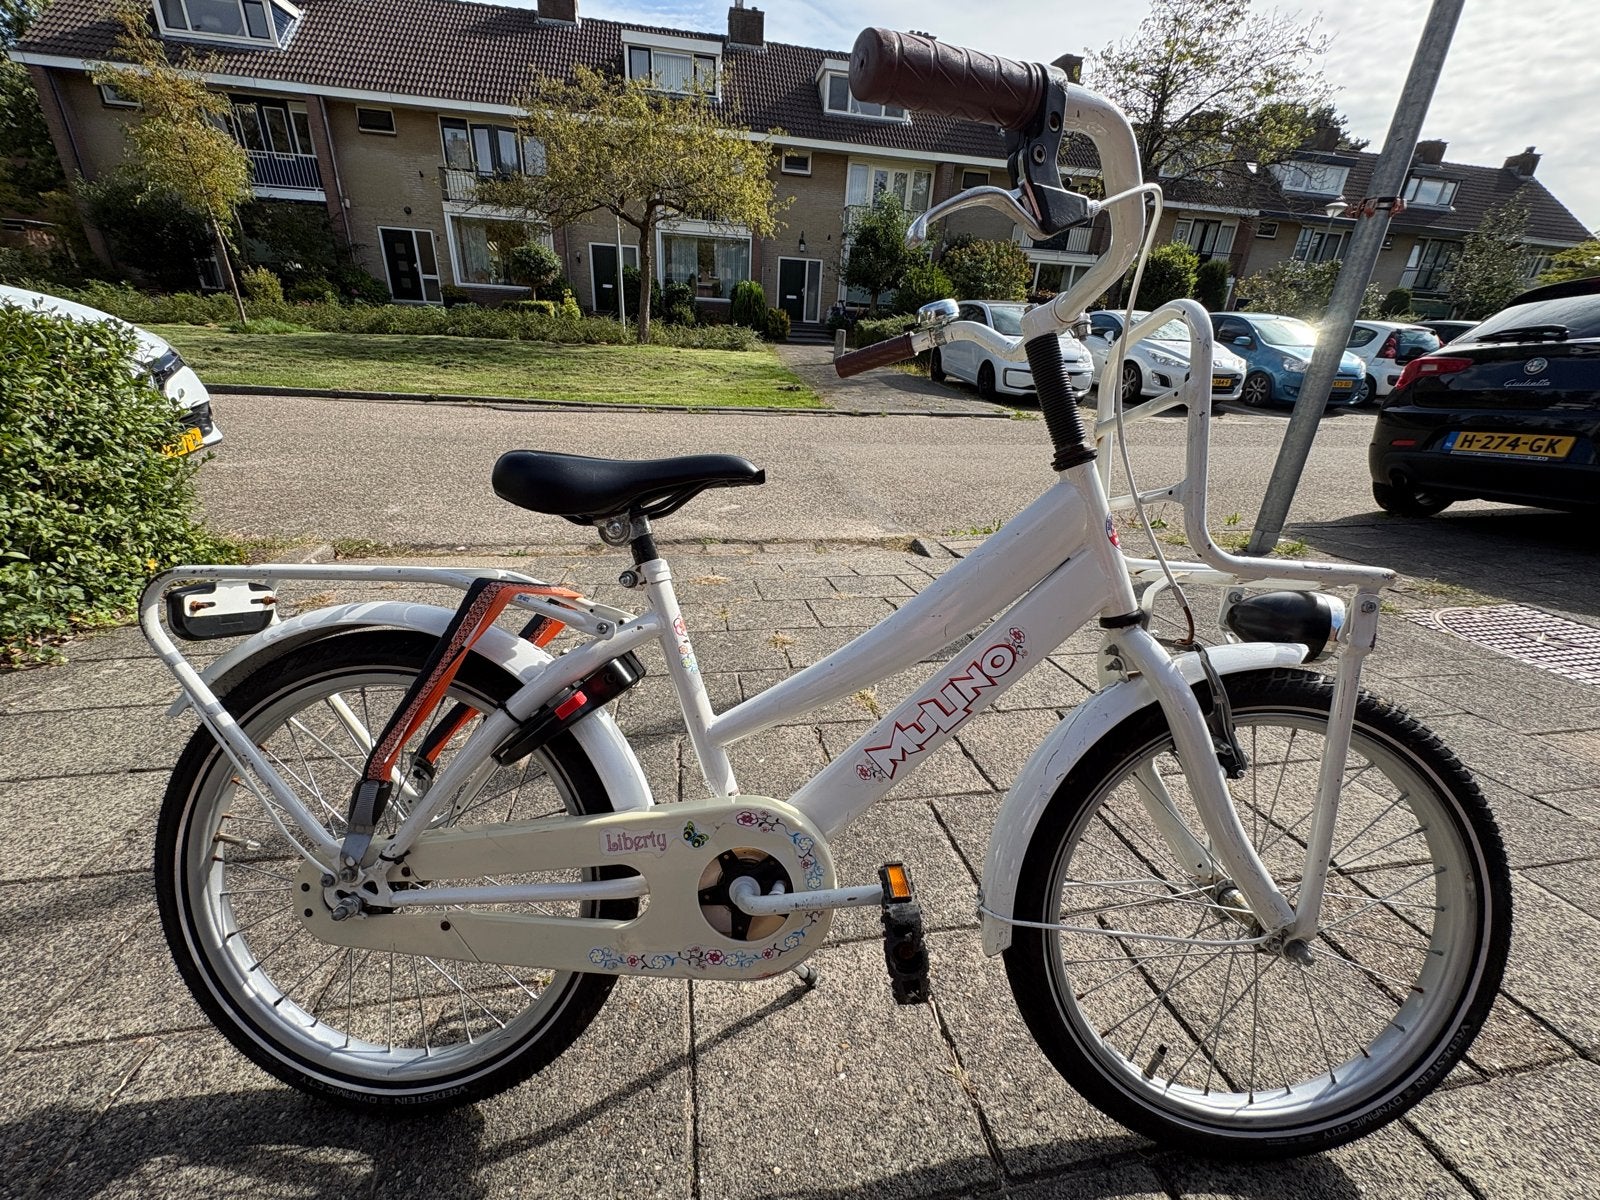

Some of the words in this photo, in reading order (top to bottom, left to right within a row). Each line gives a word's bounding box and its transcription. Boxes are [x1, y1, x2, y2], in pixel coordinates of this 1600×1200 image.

[1503, 379, 1551, 388] Giulietta
[1459, 435, 1562, 454] H-274-GK
[864, 643, 1016, 780] MULINO
[606, 831, 667, 851] Liberty
[1414, 1024, 1470, 1088] VREDESTEIN
[327, 1085, 378, 1104] DYNAMIC
[394, 1085, 469, 1105] VREDESTEIN
[1351, 1096, 1403, 1129] DYNAMIC
[1323, 1123, 1350, 1139] CITY
